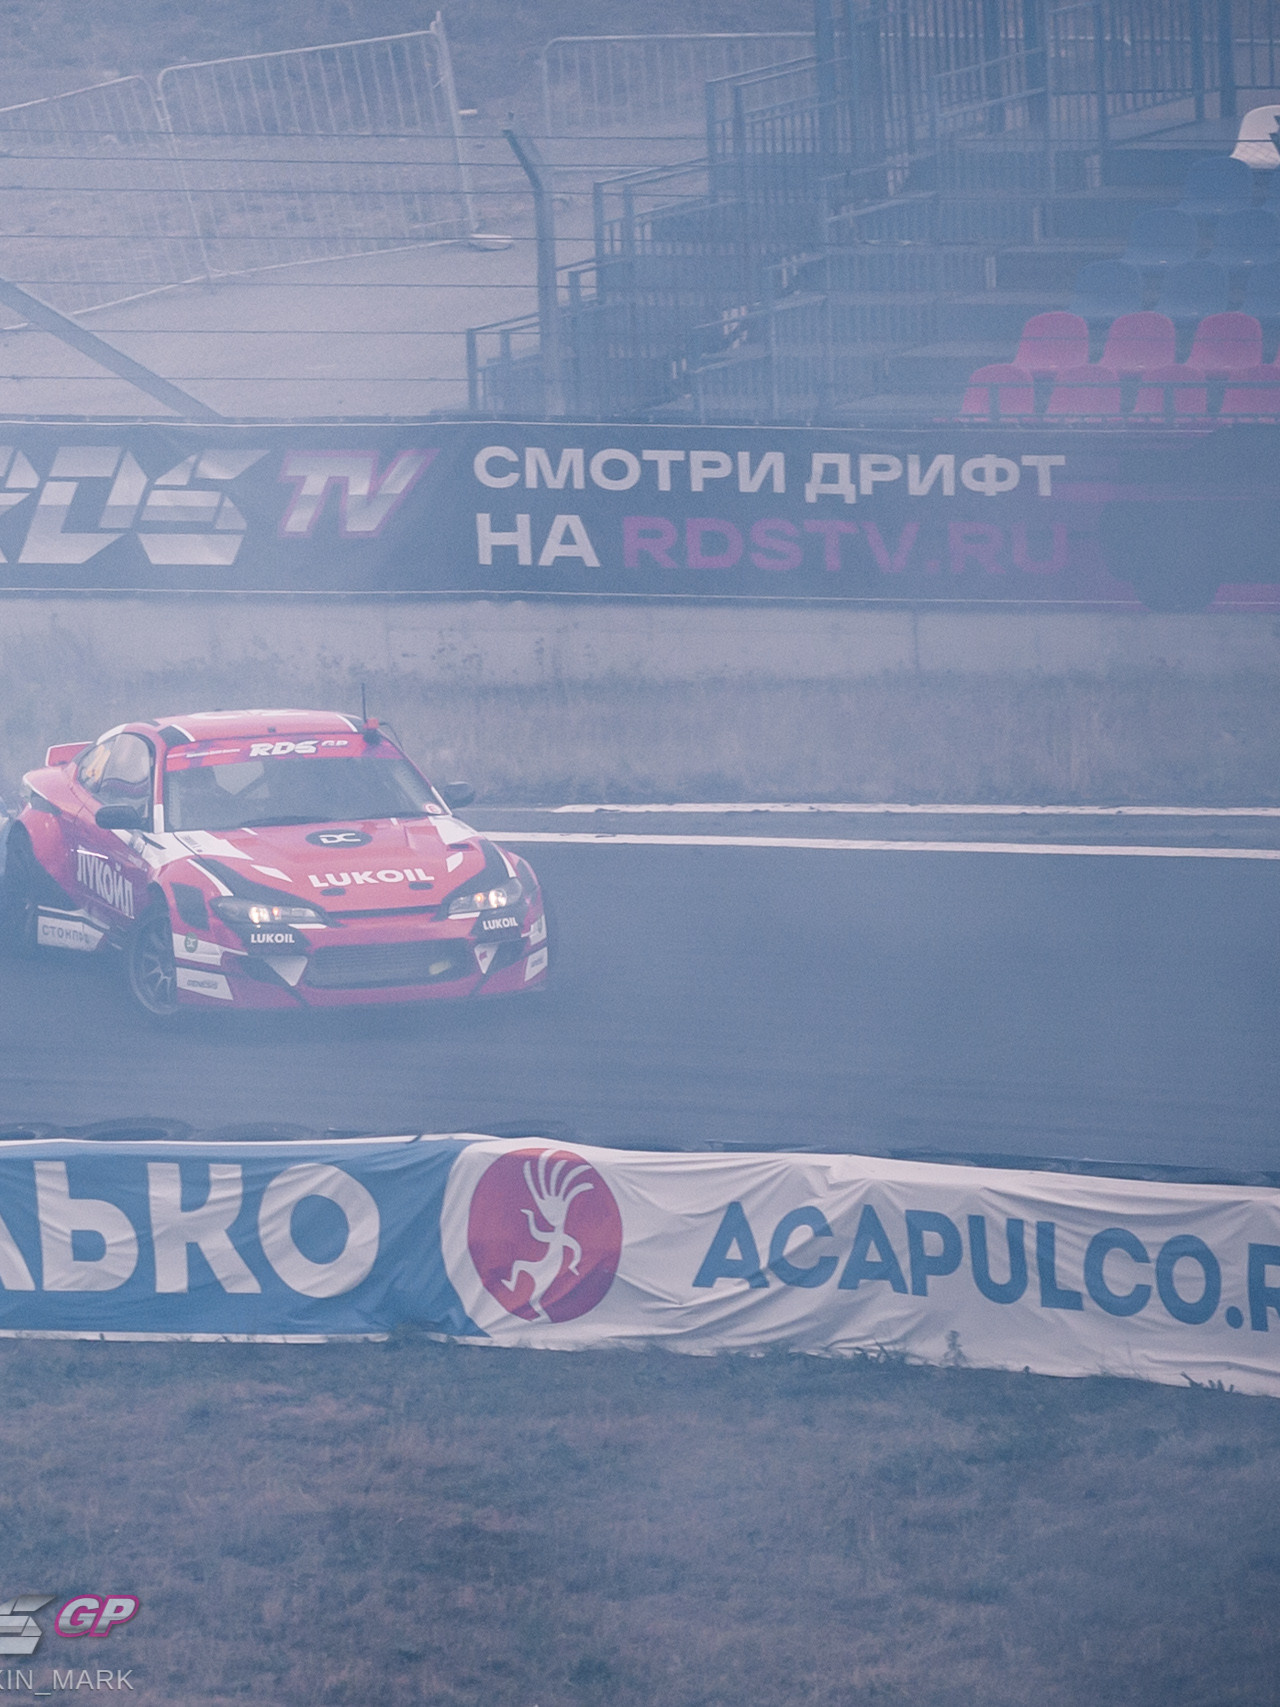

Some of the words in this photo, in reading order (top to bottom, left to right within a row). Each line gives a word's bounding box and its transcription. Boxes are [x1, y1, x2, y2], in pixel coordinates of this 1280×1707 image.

[280, 448, 440, 540] TV
[472, 445, 786, 495] СМОТРИ
[804, 452, 1066, 504] ДРИФТ
[475, 513, 601, 568] НА
[620, 515, 1071, 576] RDSTV.RU
[249, 741, 320, 756] RDS
[76, 844, 136, 920] ЛУКОЙЛ
[308, 868, 435, 888] LUKOIL
[250, 933, 295, 944] LUKOIL
[482, 917, 519, 930] LUKOIL
